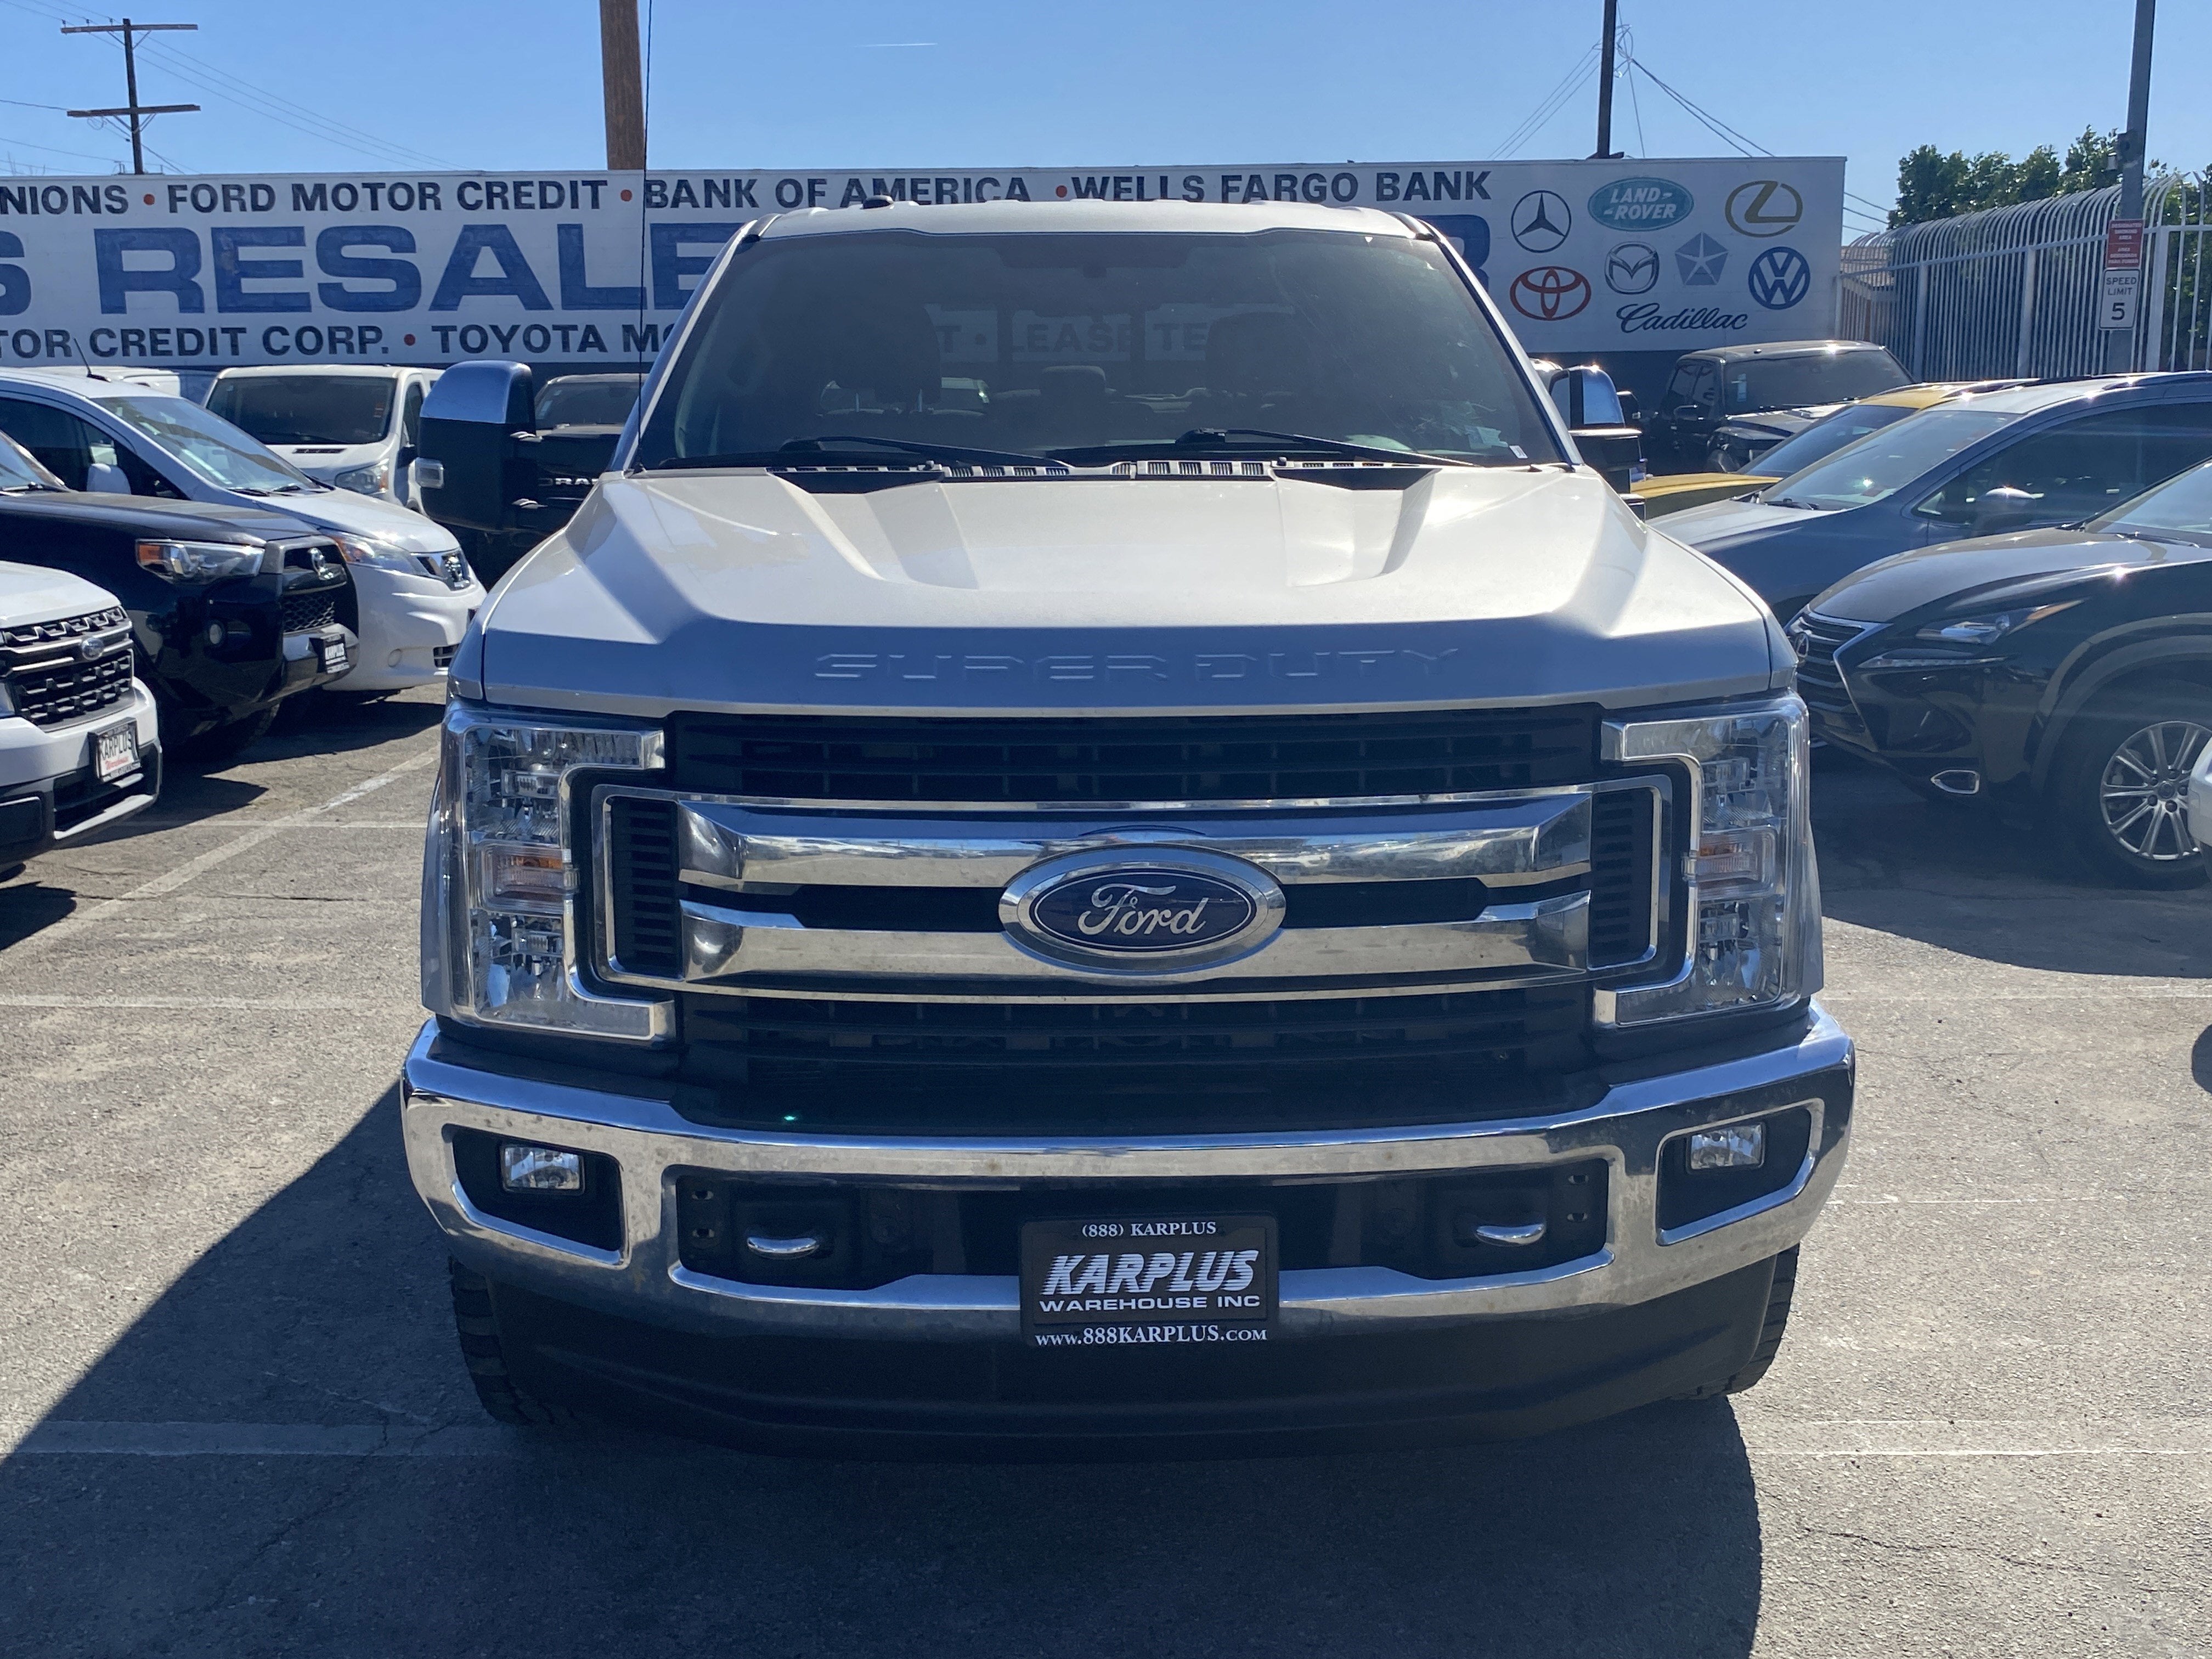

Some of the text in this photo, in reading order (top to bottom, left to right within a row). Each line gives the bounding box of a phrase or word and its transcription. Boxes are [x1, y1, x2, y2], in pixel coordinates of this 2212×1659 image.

[167, 183, 275, 213] FORD
[292, 182, 441, 212] MOTOR
[456, 179, 608, 211] CREDIT
[645, 179, 759, 209] BANK
[775, 178, 827, 208] OF
[840, 176, 1031, 208] AMERICA
[1071, 174, 1205, 202] WELLS
[1221, 172, 1358, 204] FARGO
[1376, 171, 1492, 202] BANK
[94, 223, 747, 315] RESALE
[1616, 303, 1748, 334] Cadillac
[2111, 303, 2125, 320] 5
[89, 327, 247, 358] CREDIT
[262, 325, 390, 356] CORP.
[432, 324, 608, 354] TOYOTA
[815, 648, 1459, 684] SUPER DUTY
[1077, 883, 1209, 935] Ford
[1082, 1221, 1216, 1237] (888) KARPLUS
[1040, 1249, 1259, 1295] KARPLUS
[1040, 1295, 1260, 1312] WAREHOUSE INC
